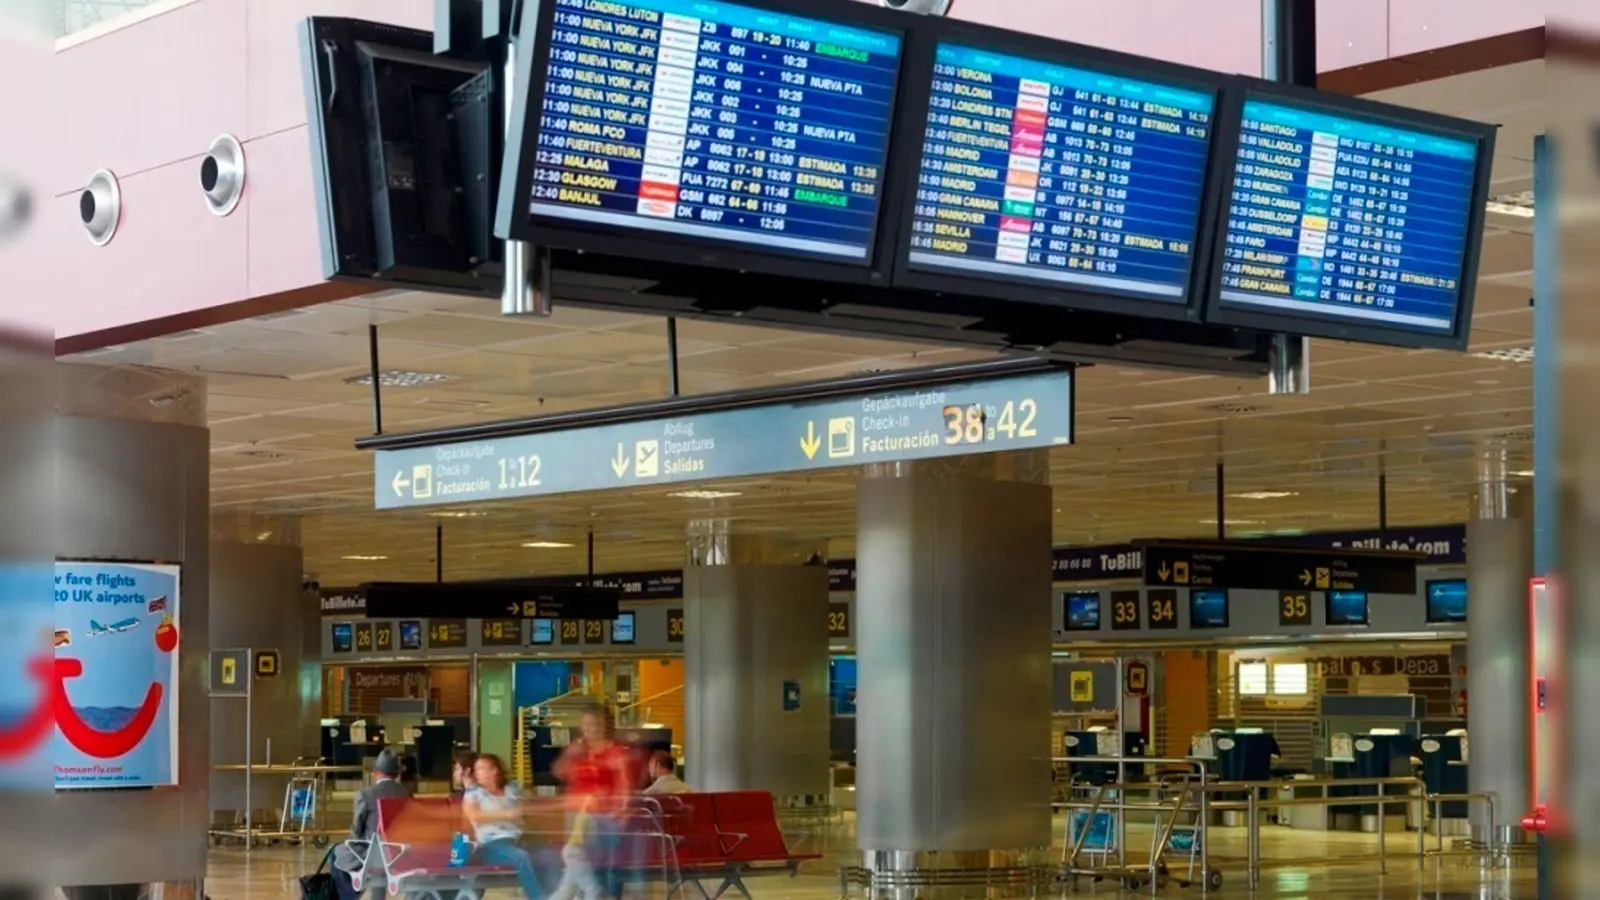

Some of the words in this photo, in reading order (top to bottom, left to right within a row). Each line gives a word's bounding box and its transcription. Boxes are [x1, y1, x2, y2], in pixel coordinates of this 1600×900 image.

[554, 12, 581, 26] 11:00
[582, 17, 613, 32] NUEVA
[614, 23, 640, 36] YORK
[640, 28, 657, 40] JFK
[728, 44, 745, 57] 001
[584, 0, 627, 16] LONDRES
[815, 42, 869, 62] EMBARQUE
[550, 48, 576, 62] 11:00
[577, 53, 608, 68] NUEVA
[610, 58, 635, 72] YORK
[635, 63, 653, 75] JFK
[552, 30, 579, 44] 11:00
[580, 35, 611, 50] NUEVA
[612, 41, 637, 54] YORK
[638, 45, 655, 57] JFK
[810, 76, 842, 92] NUEVA
[844, 82, 863, 95] PTA
[547, 65, 574, 79] 11:00
[575, 69, 606, 84] NUEVA
[607, 75, 632, 88] YORK
[632, 80, 650, 92] JFK
[957, 67, 992, 83] VERONA
[1143, 101, 1182, 118] ESTIMADA
[543, 99, 570, 113] 11:00
[570, 103, 602, 118] NUEVA
[602, 108, 628, 121] YORK
[628, 113, 646, 125] JFK
[545, 82, 572, 96] 11:00
[573, 86, 604, 101] NUEVA
[605, 91, 630, 105] YORK
[630, 96, 648, 108] JFK
[803, 125, 836, 140] NUEVA
[837, 130, 856, 143] PTA
[952, 99, 993, 115] LONDRES
[1141, 118, 1180, 134] ESTIMADA
[541, 115, 567, 130] 11:40
[568, 119, 600, 136] ROMA
[602, 125, 626, 139] FCO
[686, 139, 701, 151] AP
[798, 156, 846, 174] ESTIMADA
[539, 133, 565, 147] 11:40
[566, 137, 642, 159] FUERTEVENTURA
[684, 155, 699, 167] AP
[796, 173, 844, 190] ESTIMADA
[561, 172, 617, 191] GLASGOW
[564, 154, 609, 172] MALAGA
[794, 188, 848, 207] EMBARQUE
[532, 185, 558, 199] 12:40
[559, 188, 601, 206] BANJUL
[862, 391, 947, 413] Gepäckaufgabe
[862, 414, 909, 431] Check-in
[862, 430, 940, 453] Facturación
[942, 404, 984, 445] 38
[996, 398, 1037, 439] 42
[664, 438, 715, 456] Departures
[437, 477, 491, 495] Facturación
[518, 454, 541, 488] 12
[664, 457, 705, 474] Salidas
[1100, 551, 1143, 571] TuBill
[66, 573, 92, 586] fare
[96, 573, 136, 589] flights
[72, 590, 92, 602] UK
[96, 591, 145, 605] airports
[1283, 596, 1307, 619] 35
[1115, 601, 1136, 622] 33
[1152, 599, 1174, 621] 34
[563, 621, 578, 639] 28
[587, 621, 602, 639] 29
[669, 619, 684, 637] 30
[828, 612, 846, 630] 32
[357, 630, 371, 647] 26
[377, 630, 391, 646] 27
